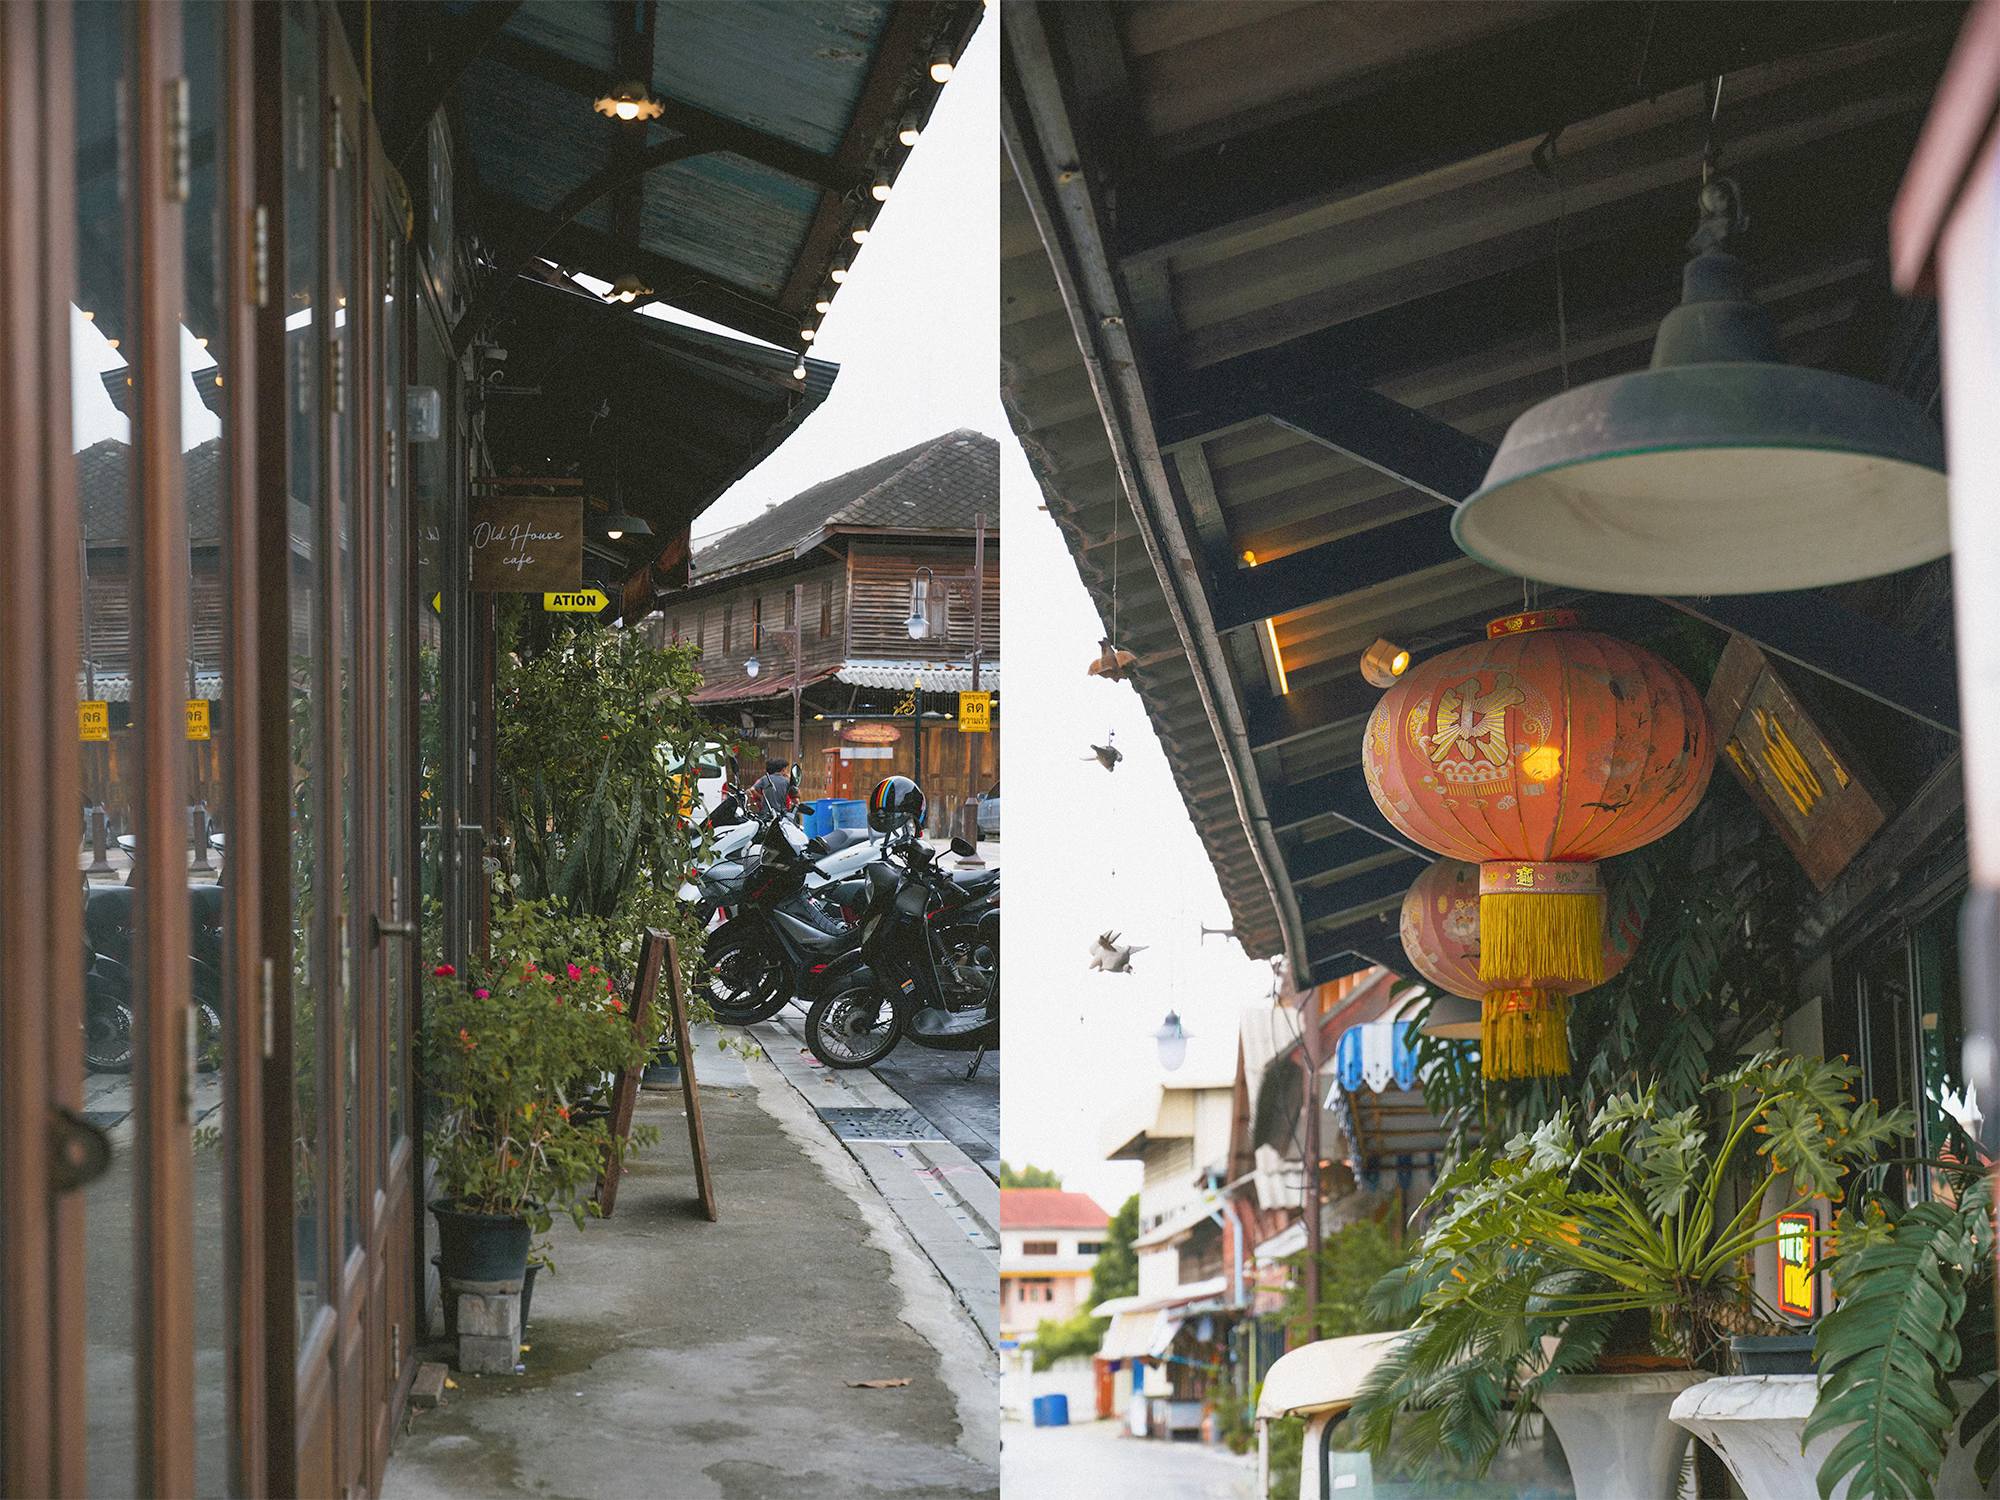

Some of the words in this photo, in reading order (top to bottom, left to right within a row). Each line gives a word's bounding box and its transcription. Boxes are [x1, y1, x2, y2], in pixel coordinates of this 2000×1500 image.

[473, 521, 507, 549] Old
[509, 522, 564, 551] House
[502, 553, 535, 571] cafe
[553, 595, 596, 606] ATION
[966, 702, 984, 713] ลด
